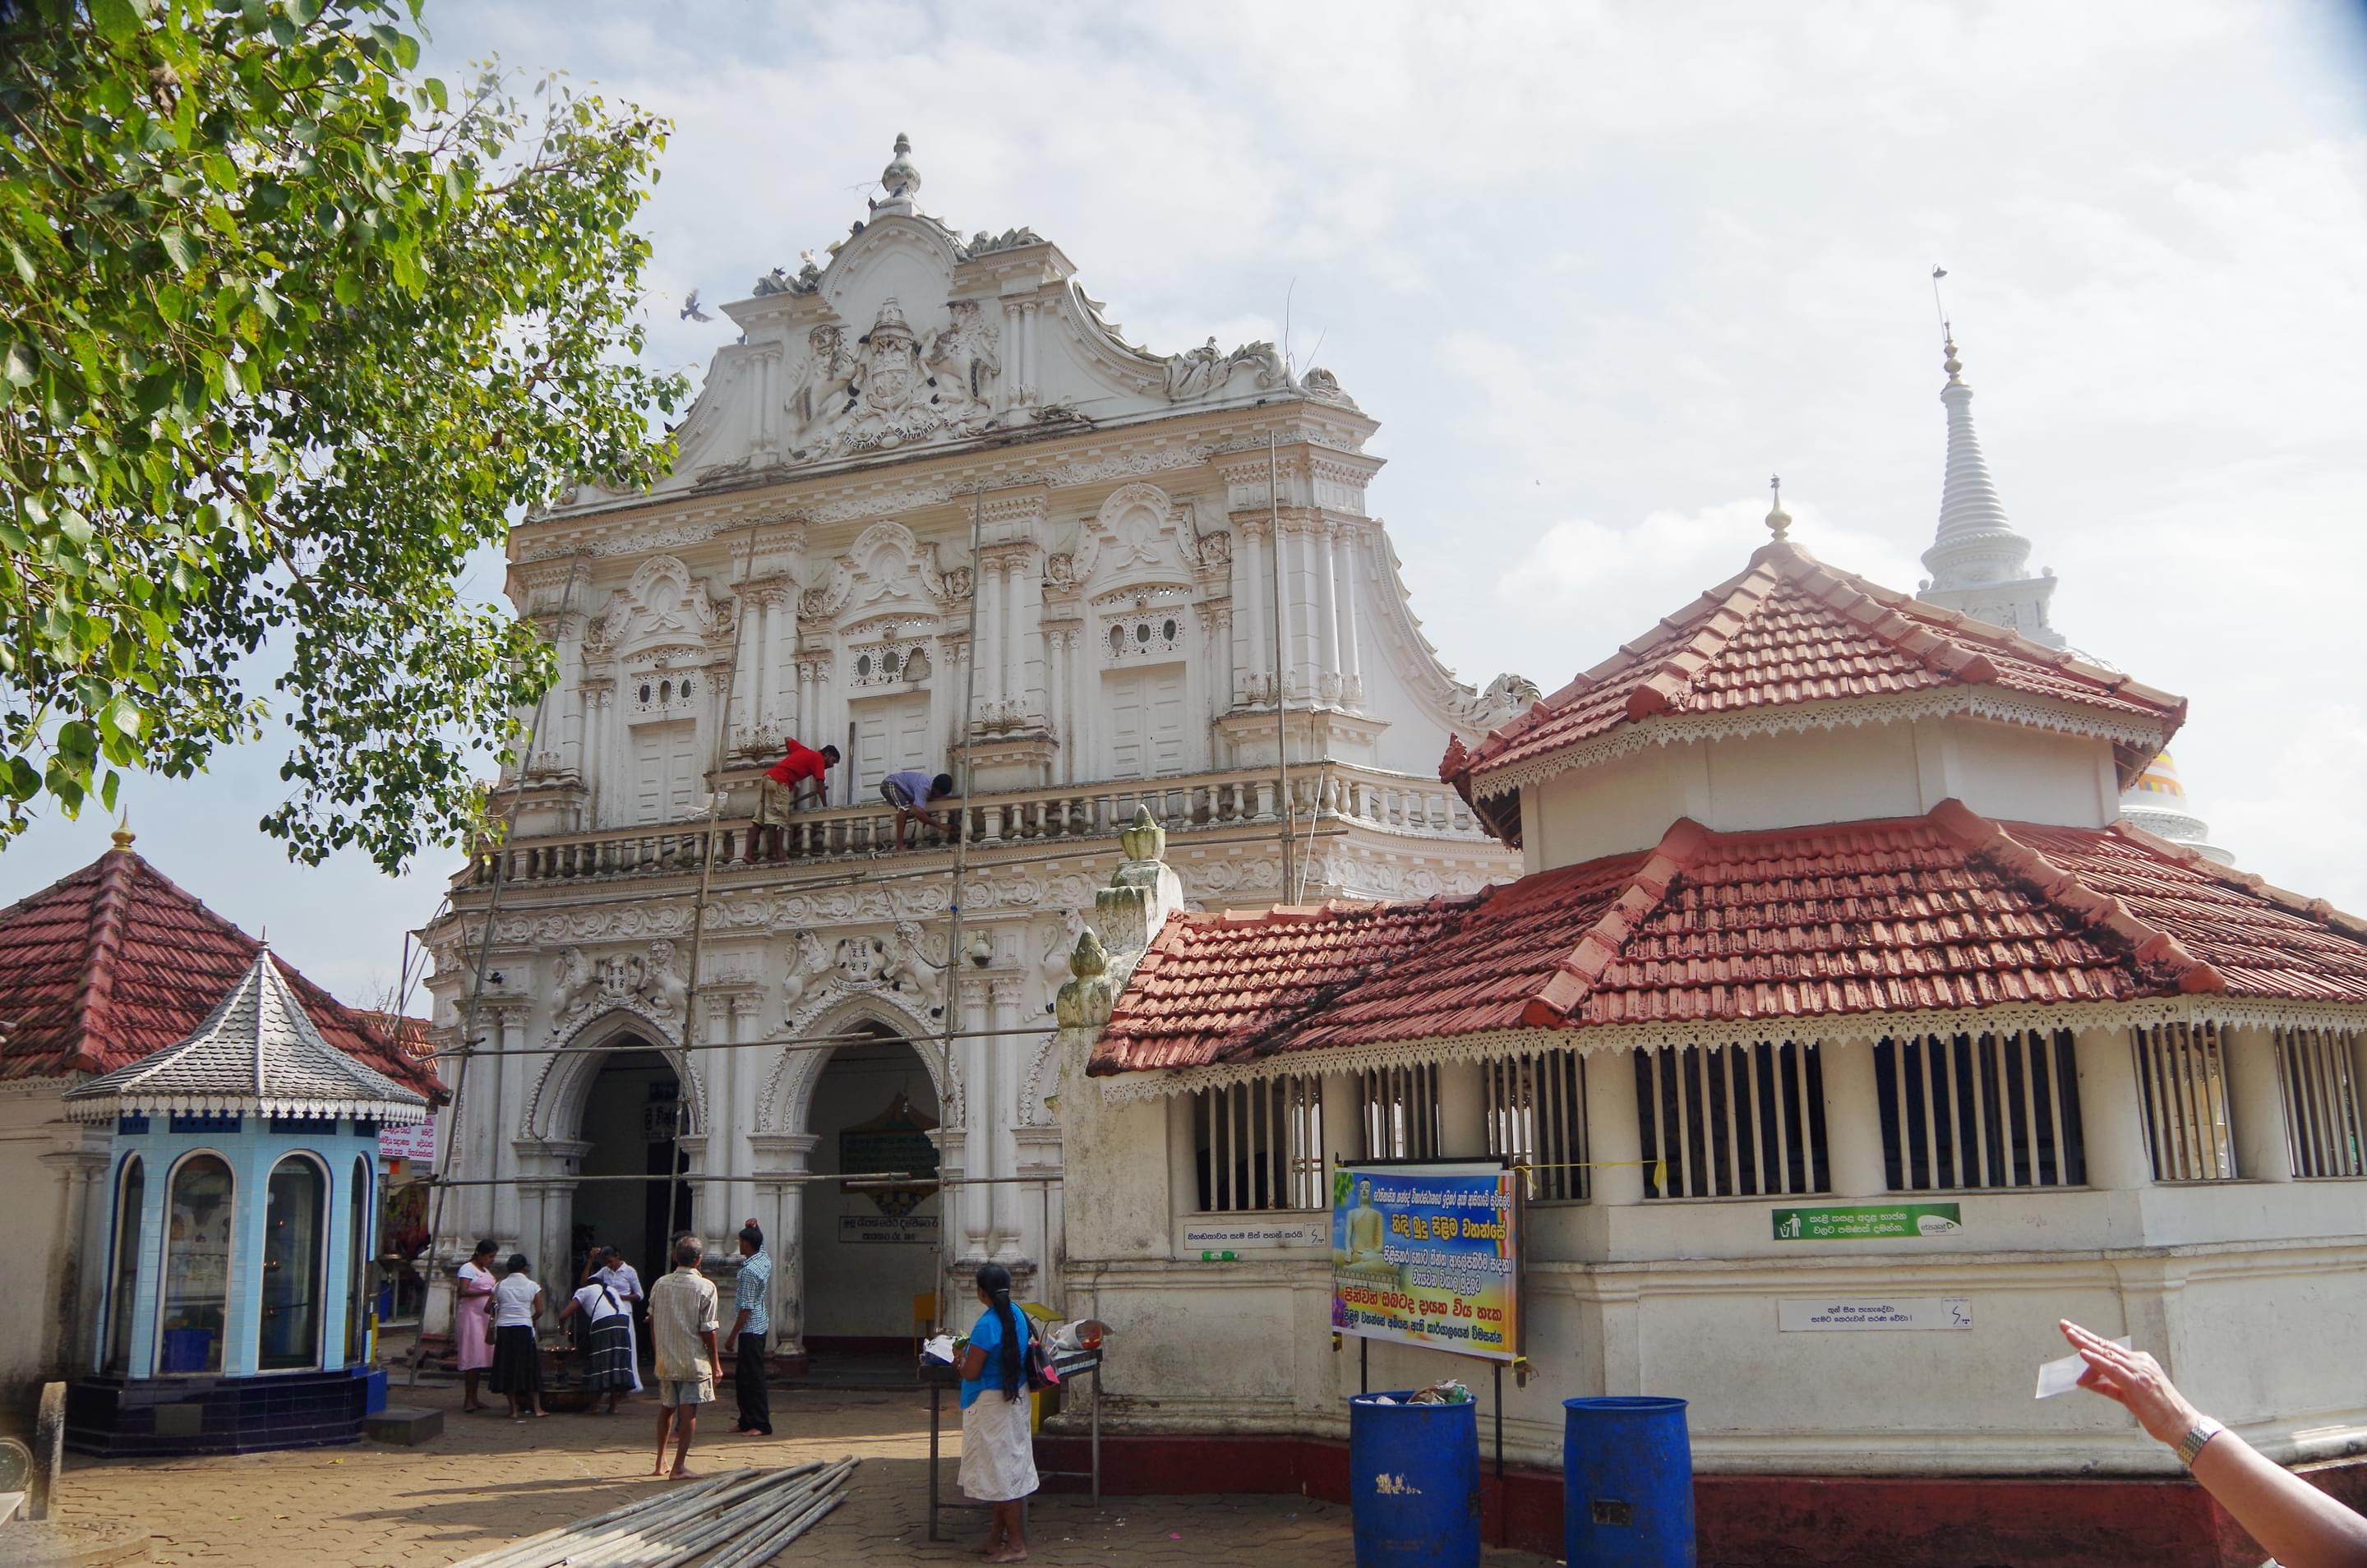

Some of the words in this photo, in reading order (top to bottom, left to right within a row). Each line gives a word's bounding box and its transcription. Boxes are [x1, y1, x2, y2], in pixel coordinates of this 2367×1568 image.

[1412, 1216, 1429, 1239] බුදු
[1432, 1216, 1458, 1240] පිළිම
[1462, 1218, 1507, 1239] වහන්සේ
[1813, 1225, 1834, 1235] වලට
[1411, 1248, 1428, 1266] කොට
[1439, 1270, 1458, 1293] විශාල
[1459, 1273, 1482, 1295] මුදලට
[1343, 1286, 1377, 1306] පින්වත්
[1381, 1291, 1416, 1314] ඔබටද
[1419, 1299, 1447, 1316] දායක
[1452, 1298, 1473, 1317] විය
[1476, 1305, 1502, 1322] හැක
